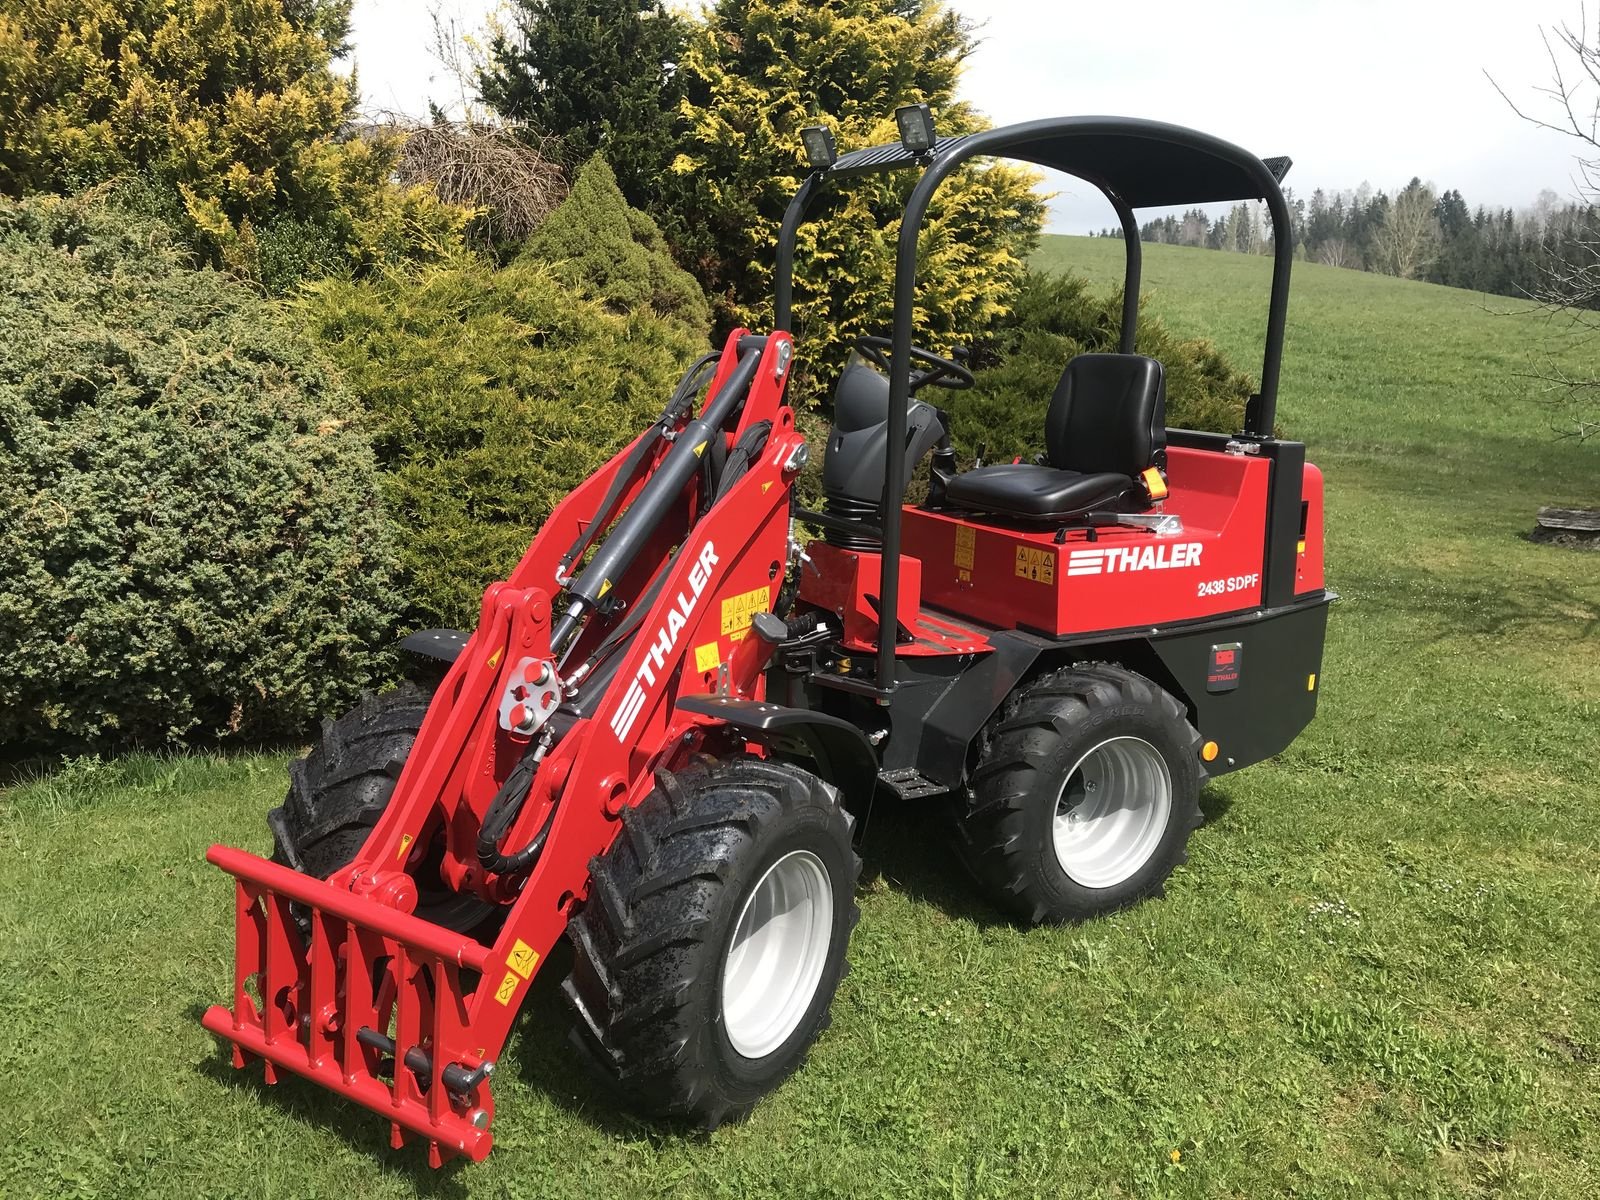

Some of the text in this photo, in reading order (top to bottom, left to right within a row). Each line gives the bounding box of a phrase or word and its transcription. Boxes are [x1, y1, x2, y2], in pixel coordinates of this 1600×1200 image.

[1104, 543, 1203, 573] THALER
[1198, 574, 1259, 597] 2438 SDPF
[636, 540, 720, 687] THALER
